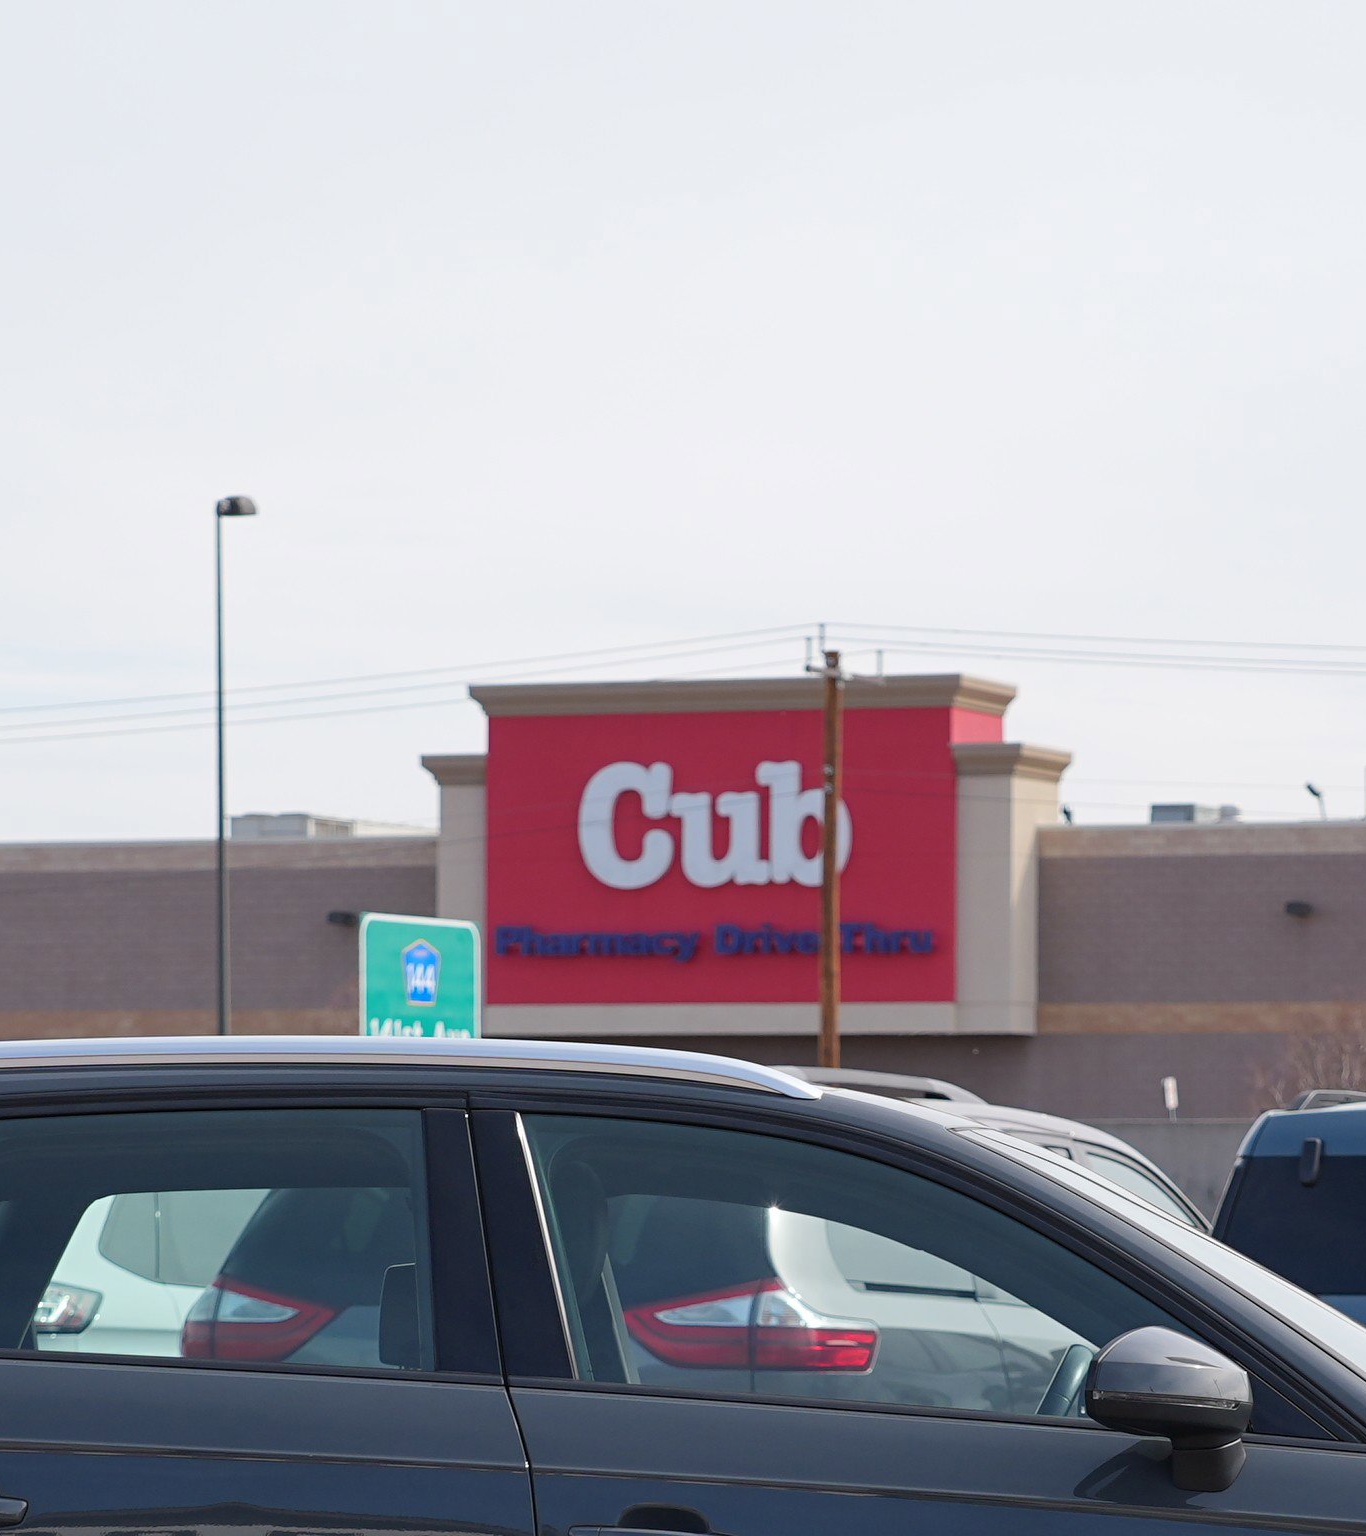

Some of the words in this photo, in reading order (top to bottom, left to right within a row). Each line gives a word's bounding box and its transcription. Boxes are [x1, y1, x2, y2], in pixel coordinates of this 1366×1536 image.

[578, 761, 853, 890] Cub
[495, 926, 701, 963] Pharmacy
[715, 923, 822, 957] Drive
[839, 923, 935, 955] Thru
[406, 961, 437, 995] 144
